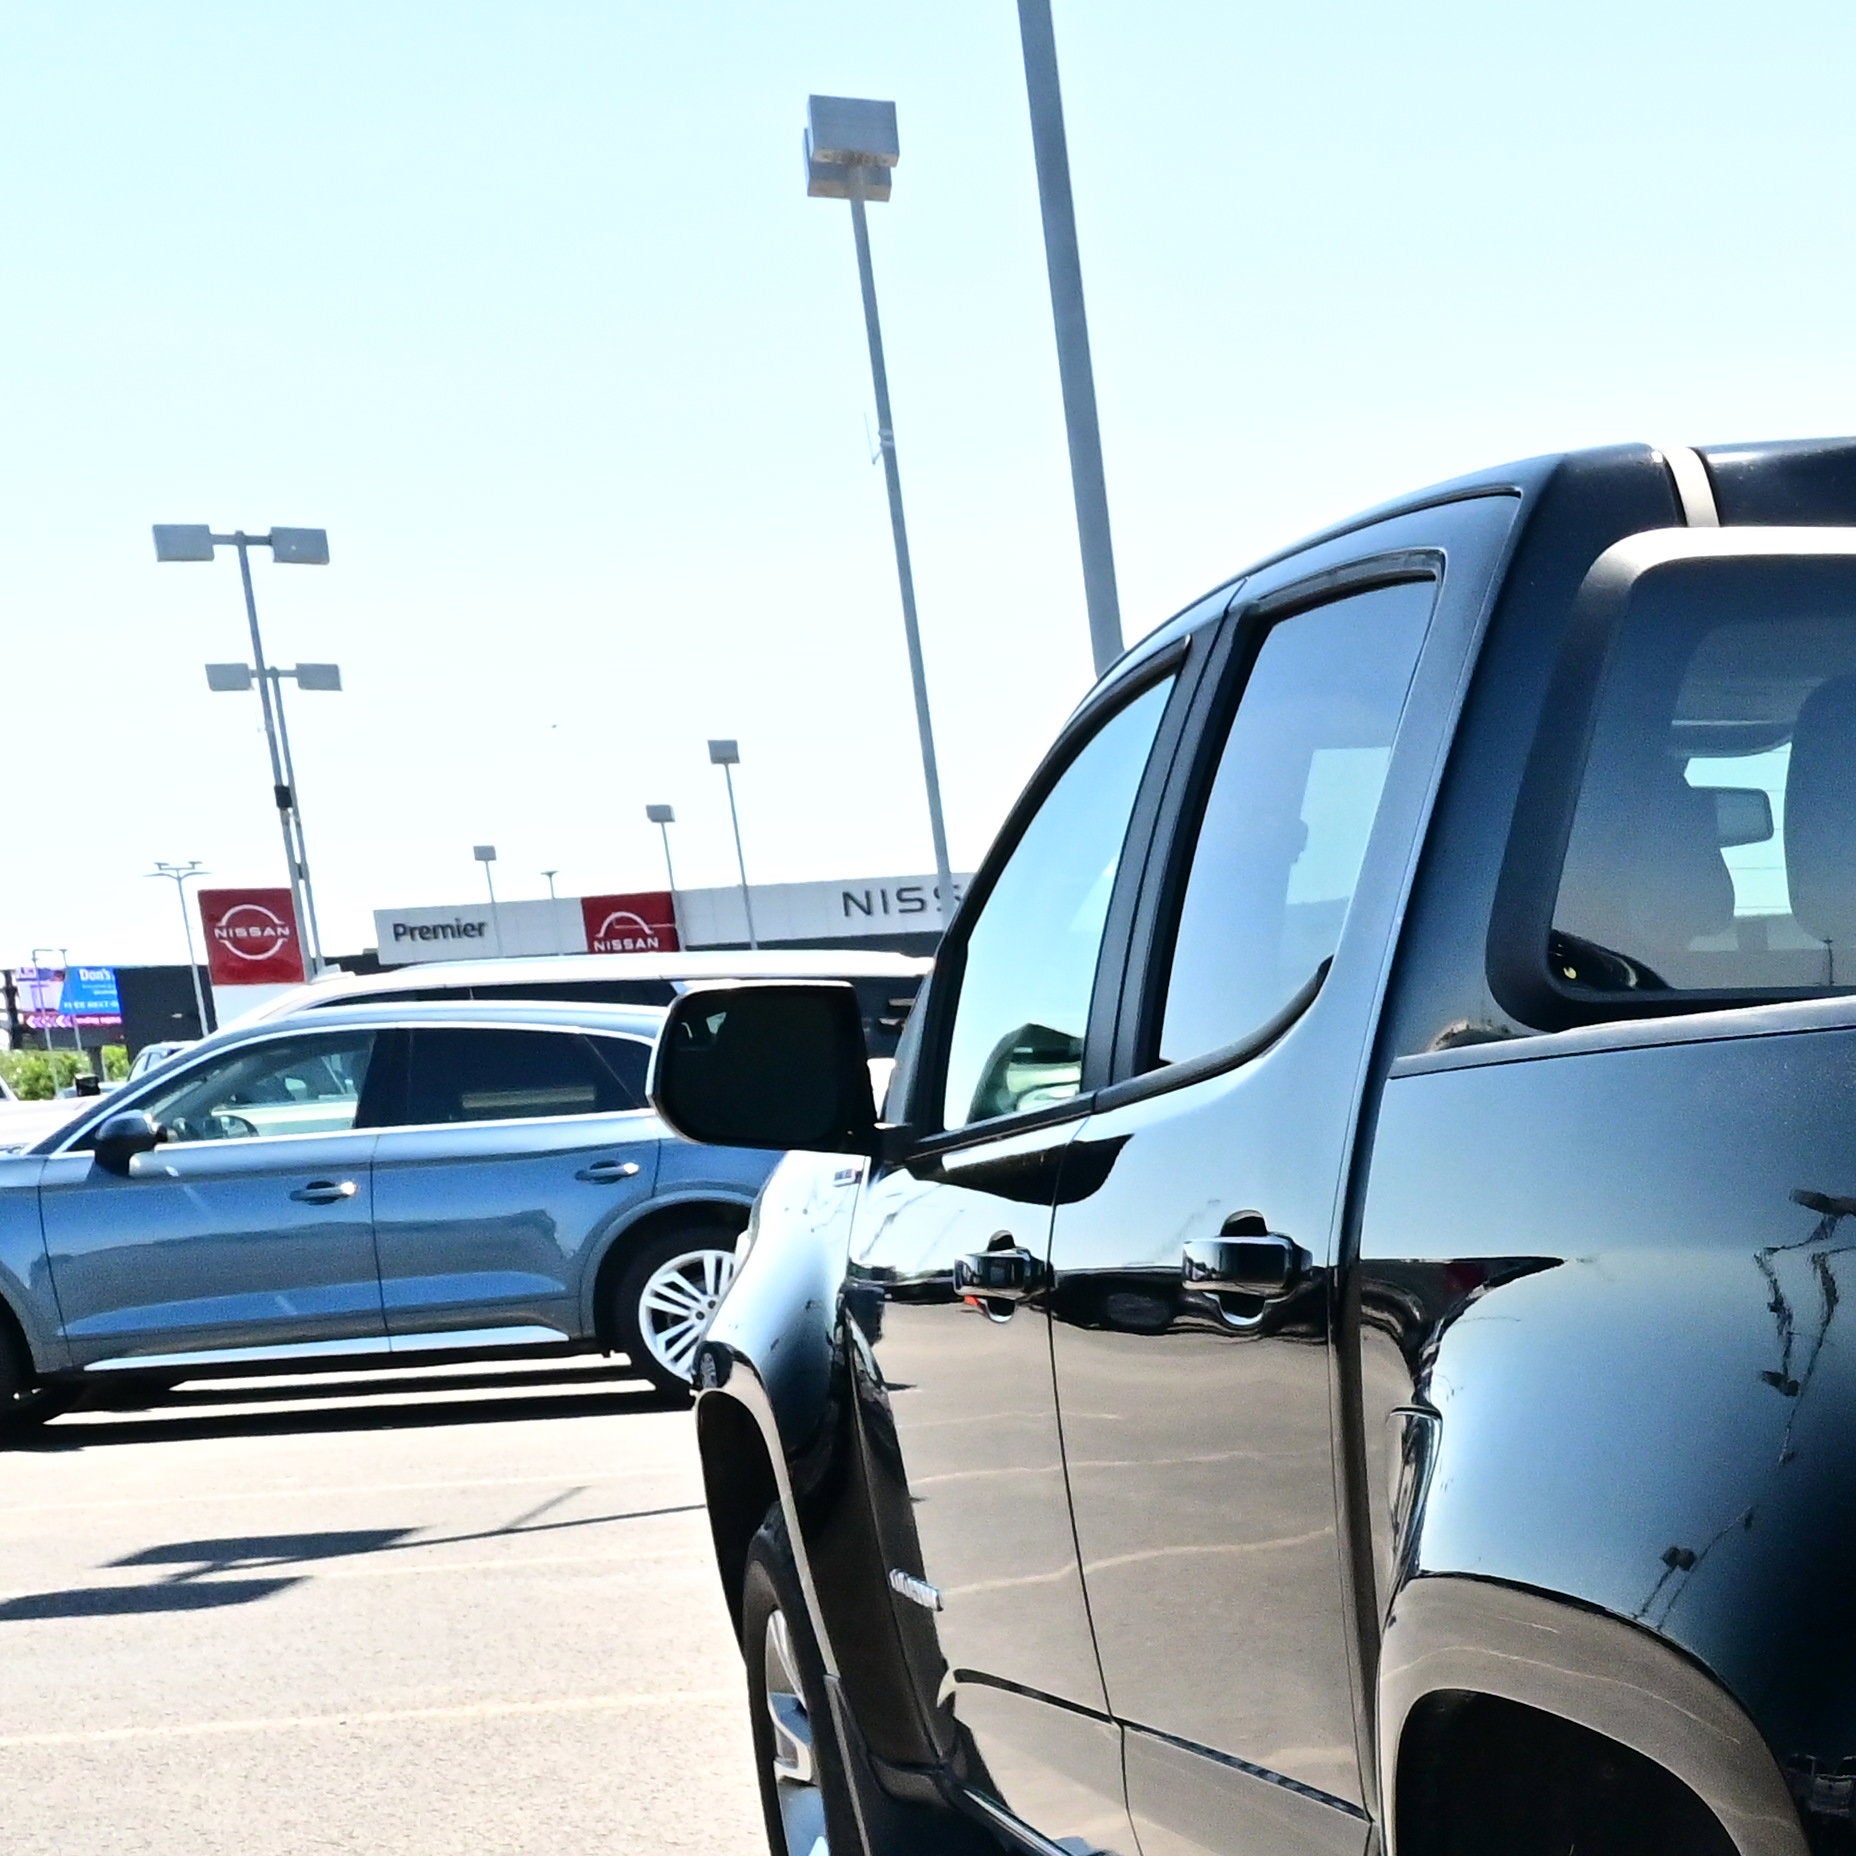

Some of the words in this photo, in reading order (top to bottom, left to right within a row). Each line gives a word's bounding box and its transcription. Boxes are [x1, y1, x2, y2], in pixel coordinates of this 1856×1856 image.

[214, 925, 290, 939] NISSAN
[392, 918, 487, 942] Premier
[594, 936, 659, 953] NISSAN
